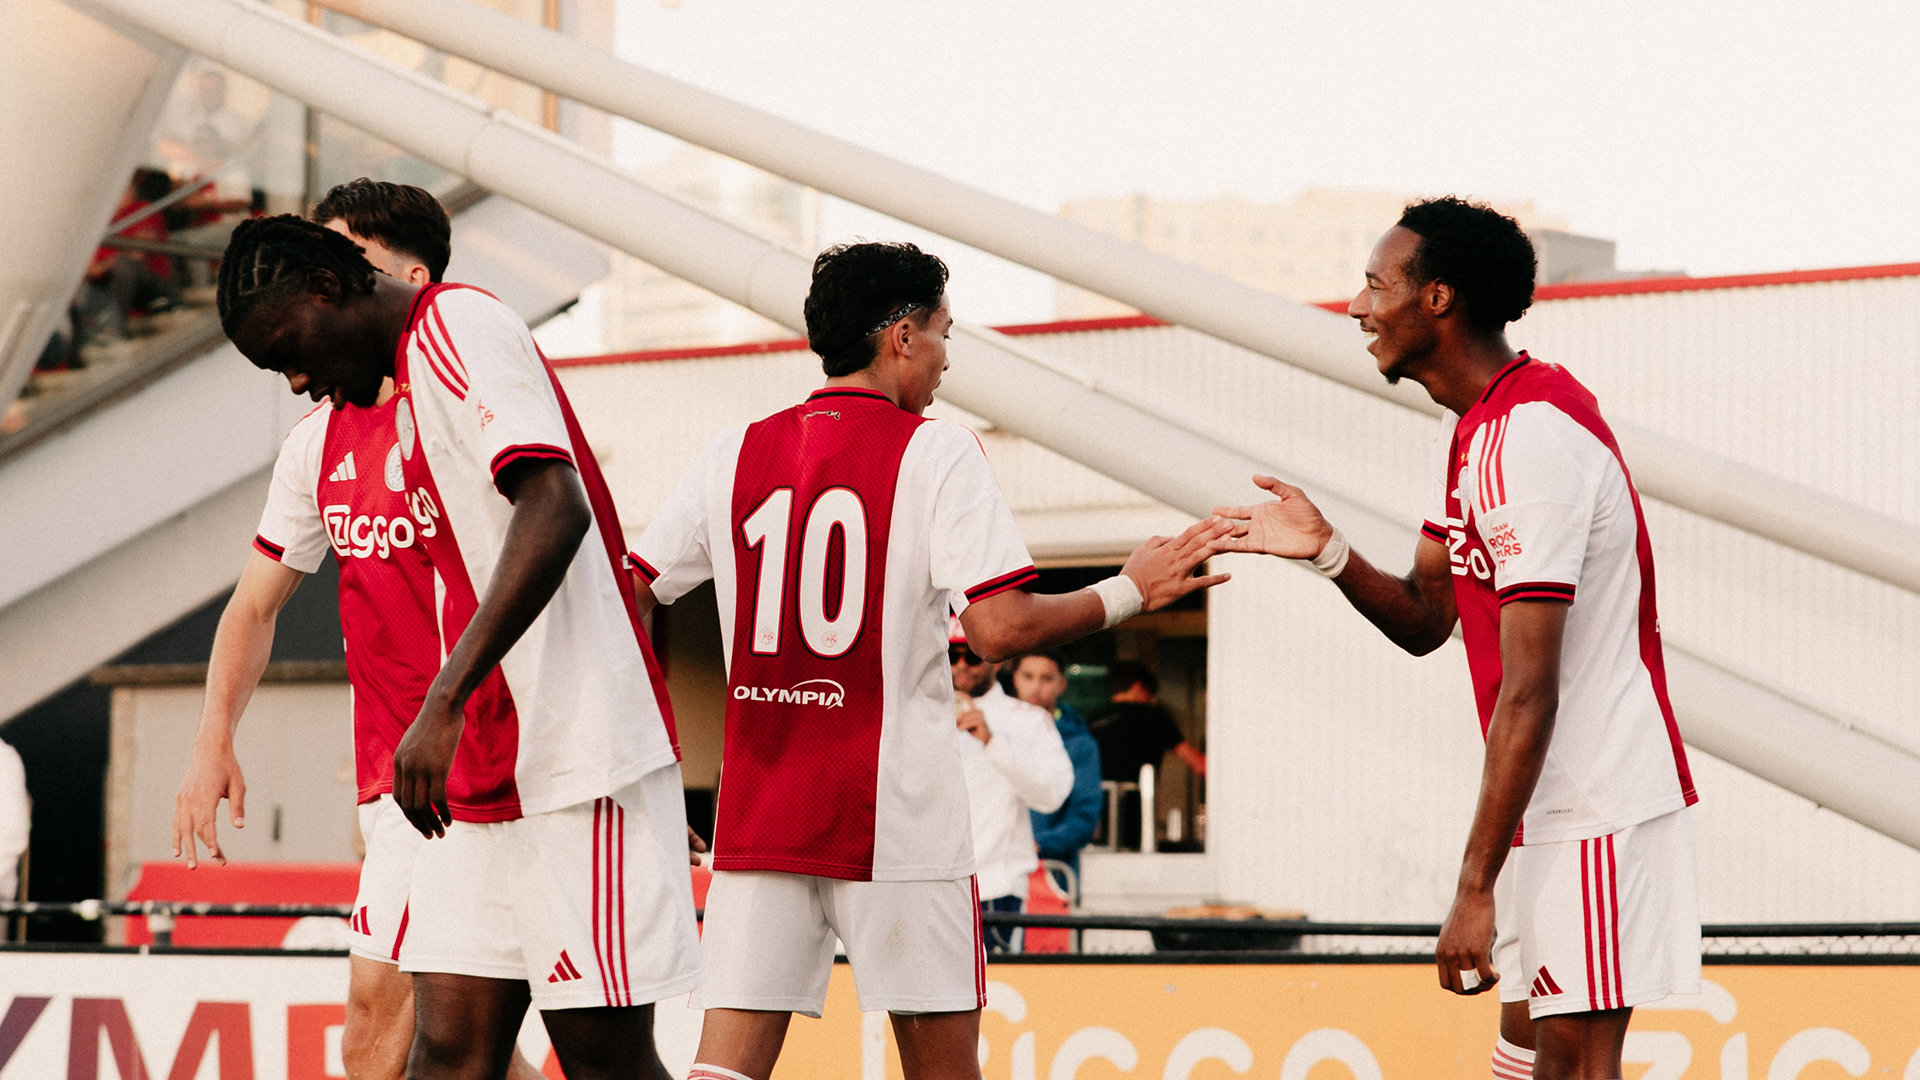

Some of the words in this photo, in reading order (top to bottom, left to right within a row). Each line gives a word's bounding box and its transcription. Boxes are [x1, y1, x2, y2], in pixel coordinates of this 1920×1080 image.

[1491, 522, 1509, 533] TEAM
[740, 485, 869, 659] 10
[733, 682, 844, 708] OLYMPIA
